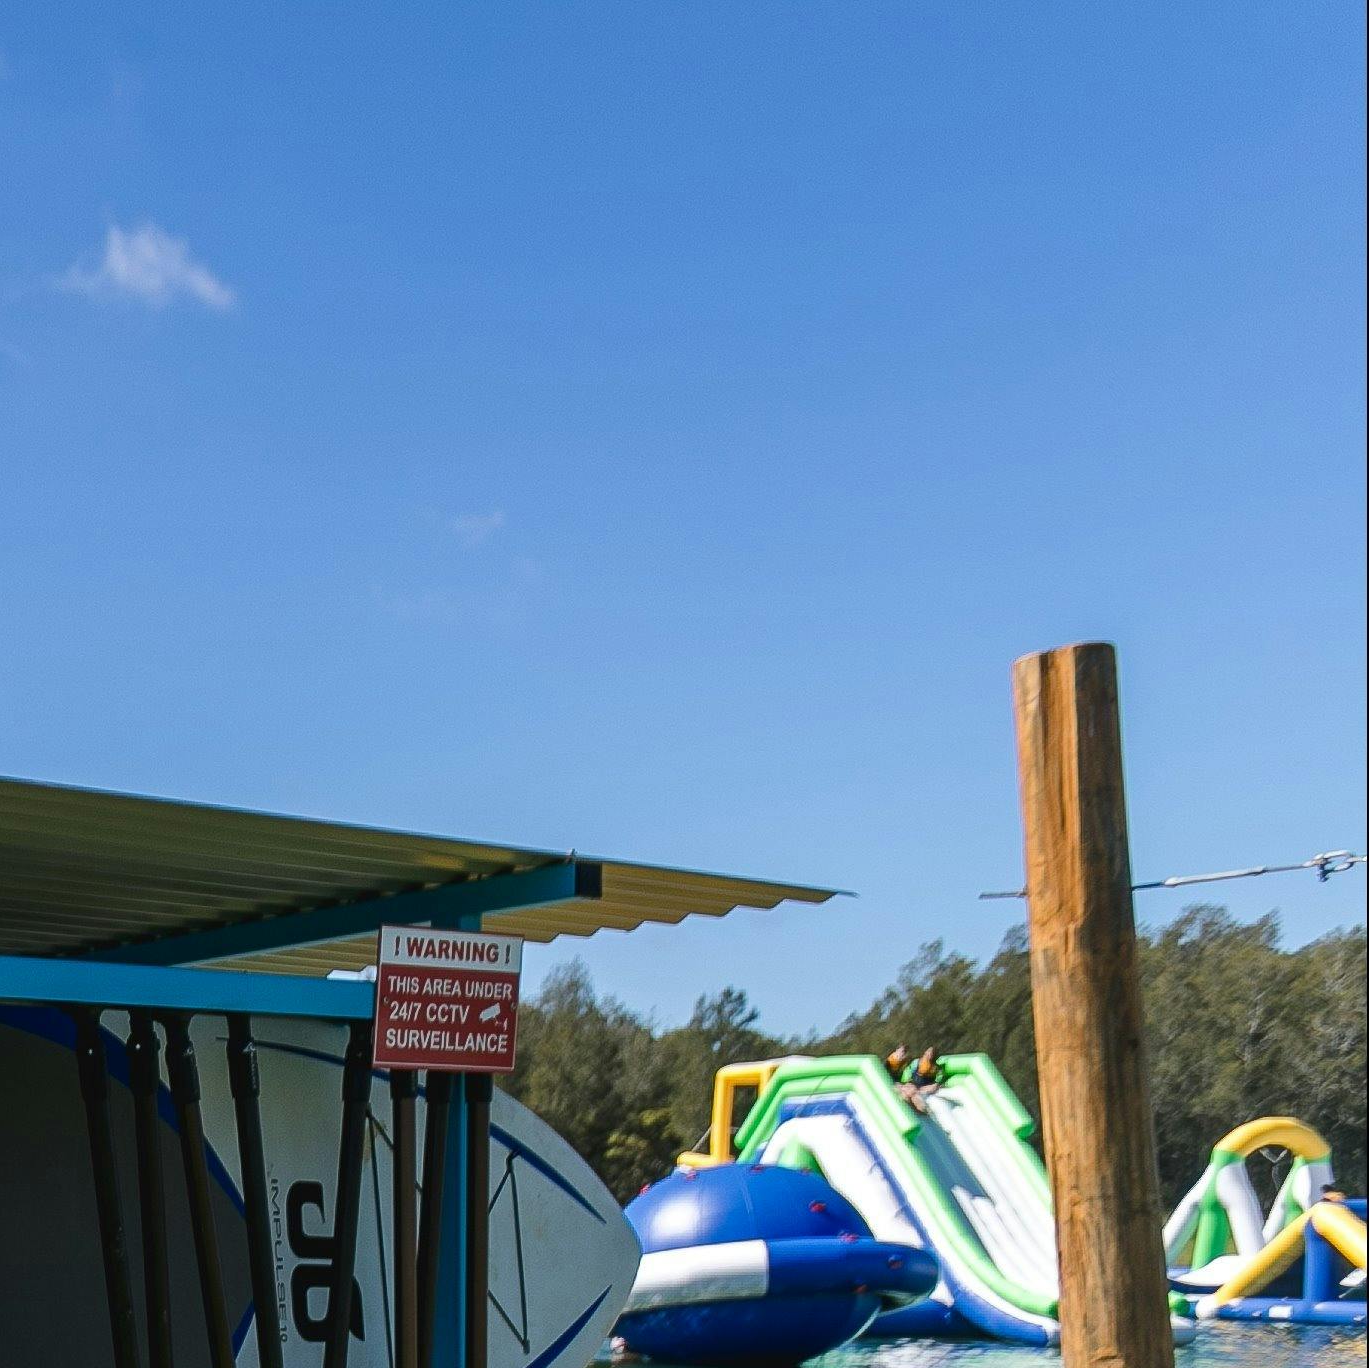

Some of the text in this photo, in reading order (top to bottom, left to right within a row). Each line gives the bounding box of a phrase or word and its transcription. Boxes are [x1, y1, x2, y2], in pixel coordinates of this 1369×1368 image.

[406, 936, 499, 964] WARNING
[388, 975, 512, 1001] THIS AREA UNDER
[388, 1001, 471, 1025] 24/7 CCTV
[385, 1028, 509, 1053] SURVEILLANCE
[270, 1178, 287, 1321] IMPULSE
